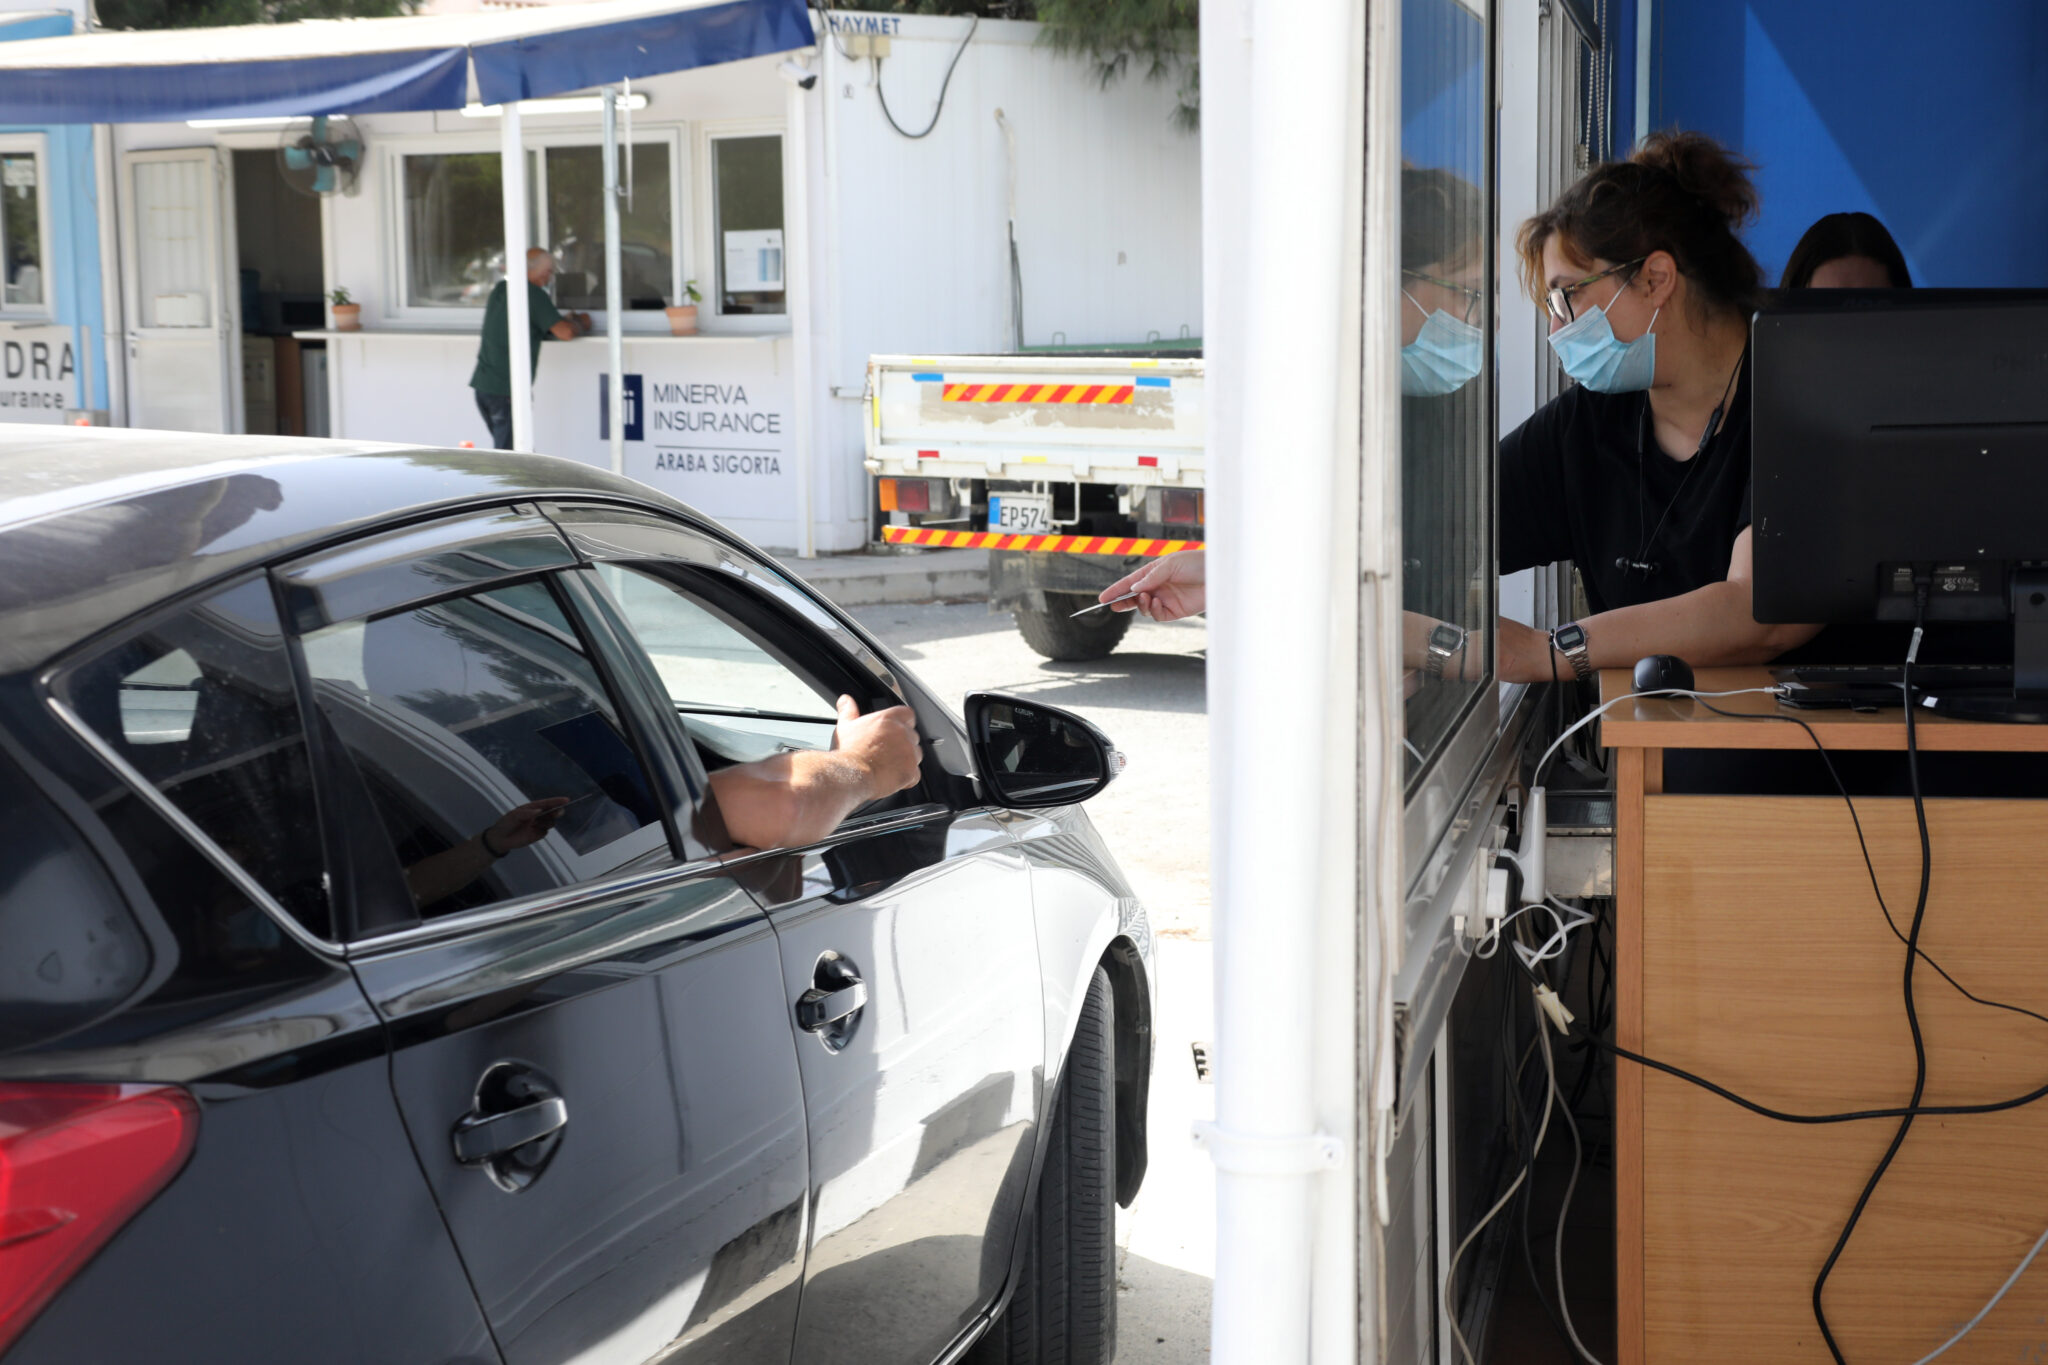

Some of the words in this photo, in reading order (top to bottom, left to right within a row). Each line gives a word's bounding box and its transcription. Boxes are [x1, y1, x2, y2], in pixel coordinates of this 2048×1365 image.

[4, 340, 75, 381] DRA
[653, 383, 748, 405] MINERVA
[654, 411, 781, 434] INSURANCE
[655, 453, 707, 473] ARABA
[712, 455, 782, 475] SIGORTA
[1000, 506, 1049, 529] EP574
